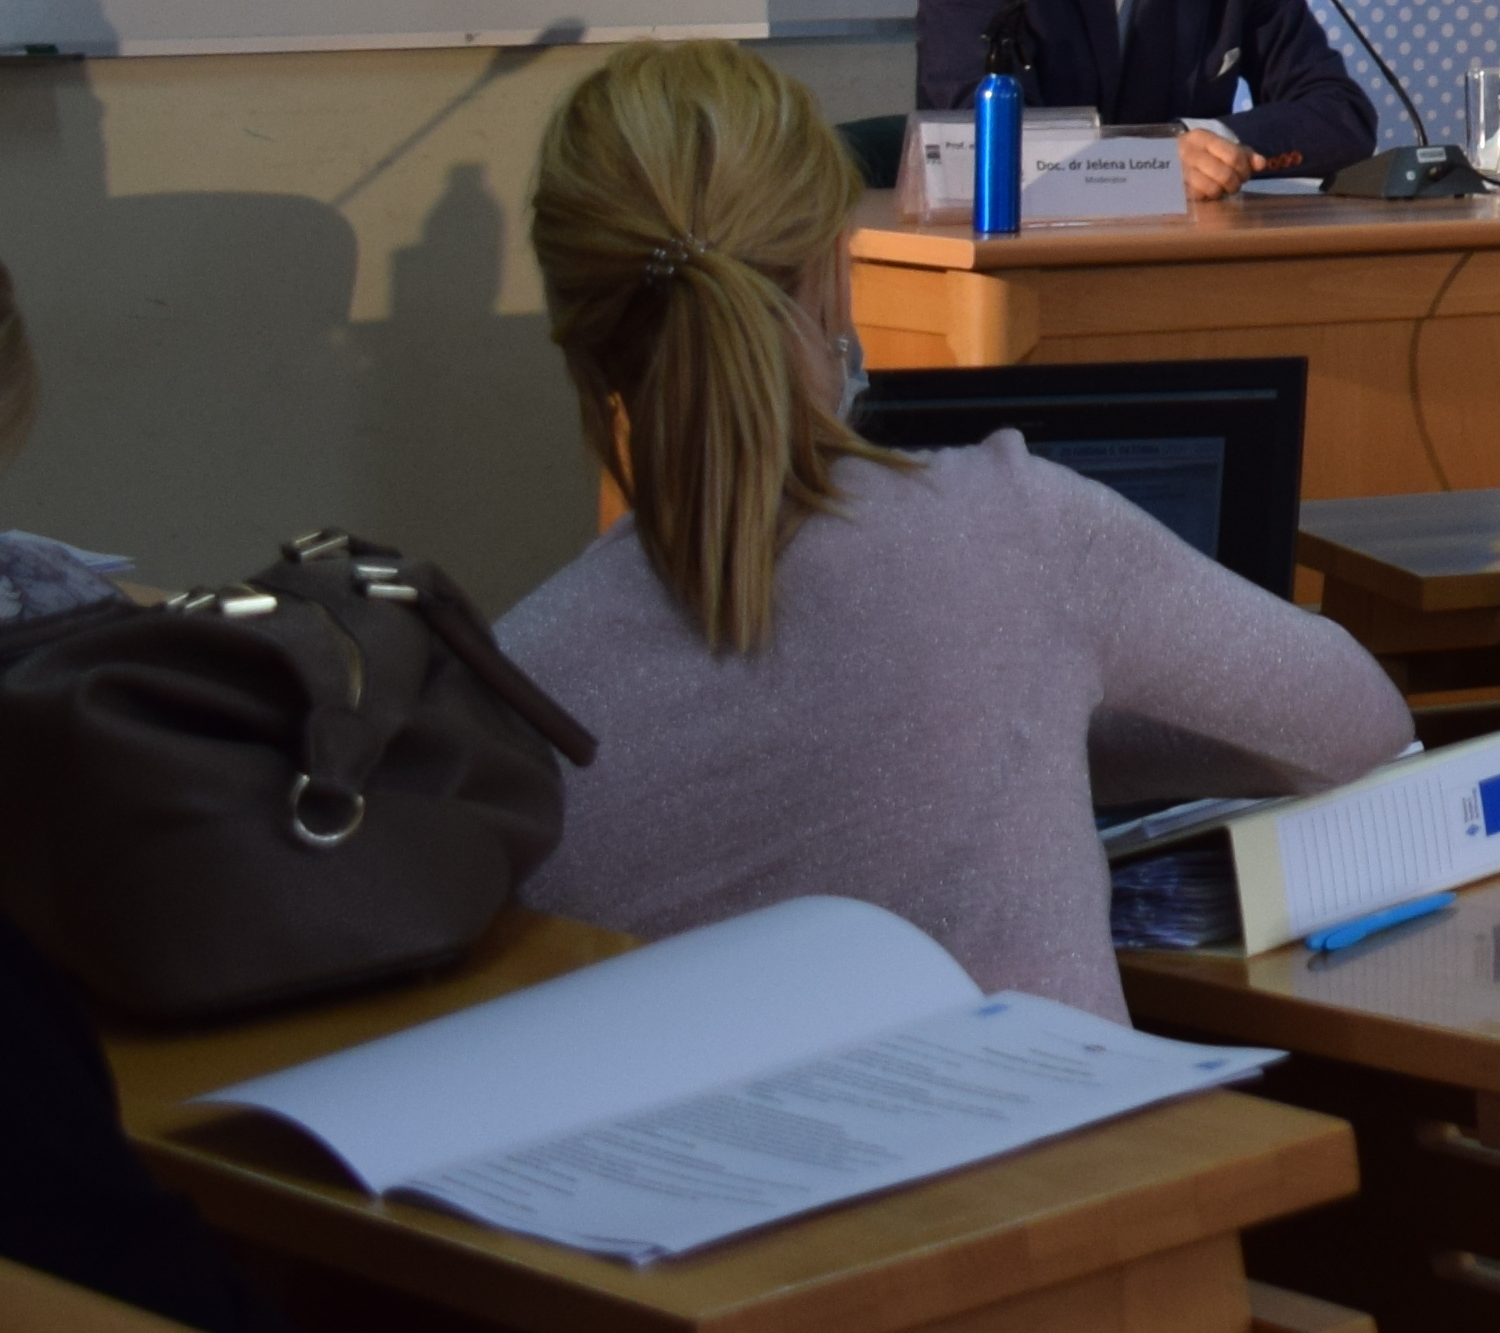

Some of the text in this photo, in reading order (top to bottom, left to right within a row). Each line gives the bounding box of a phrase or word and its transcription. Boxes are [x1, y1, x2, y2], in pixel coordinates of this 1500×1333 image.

[1035, 158, 1171, 172] Doc. dr Jelena Lončar
